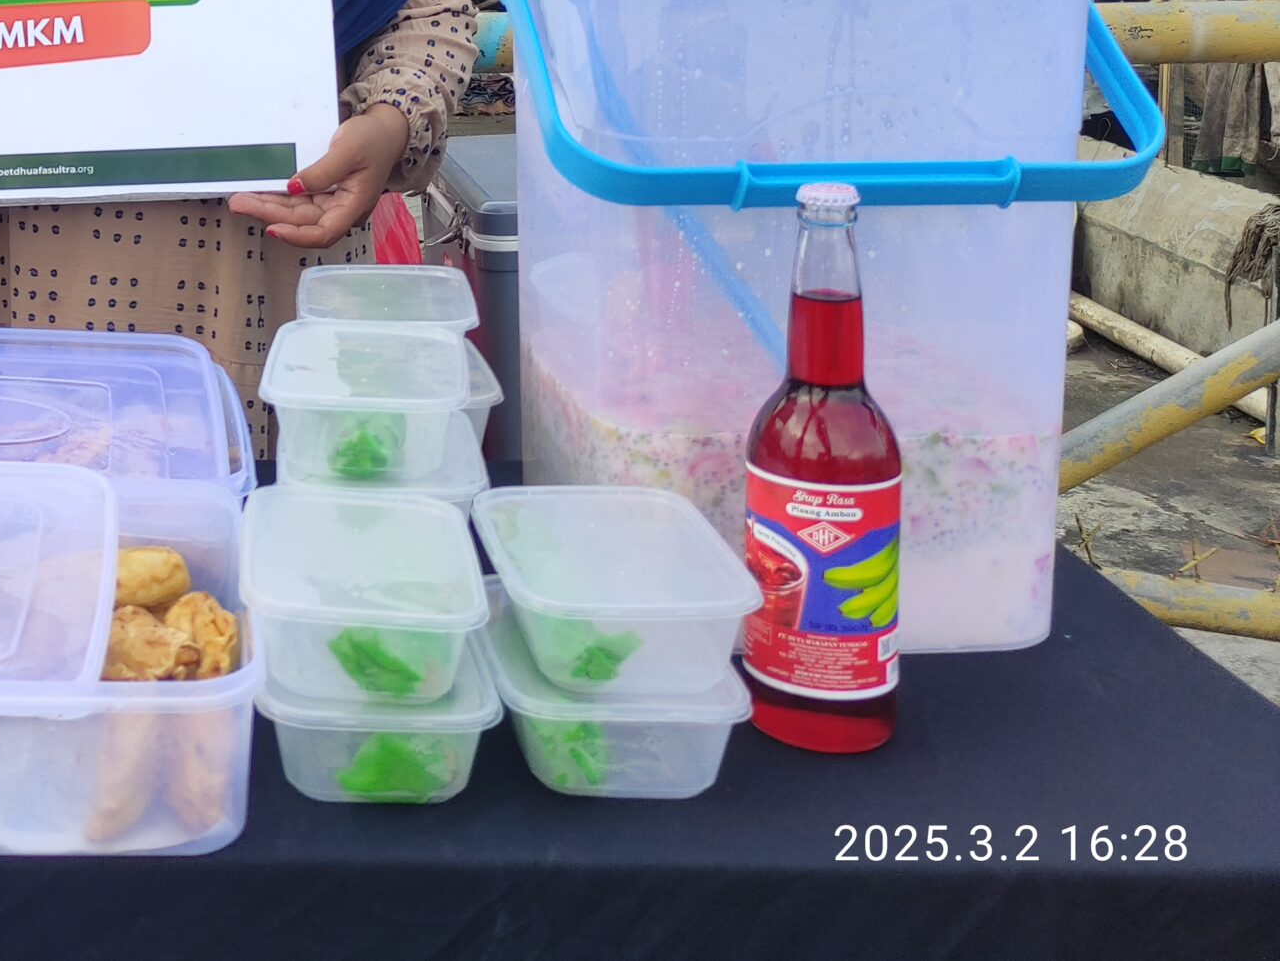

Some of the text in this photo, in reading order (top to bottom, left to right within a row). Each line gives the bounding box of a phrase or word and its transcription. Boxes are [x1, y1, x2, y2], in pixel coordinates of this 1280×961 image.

[792, 490, 856, 506] Sirup Rasa
[791, 505, 857, 518] Pisang Ambon
[811, 526, 836, 547] DHT
